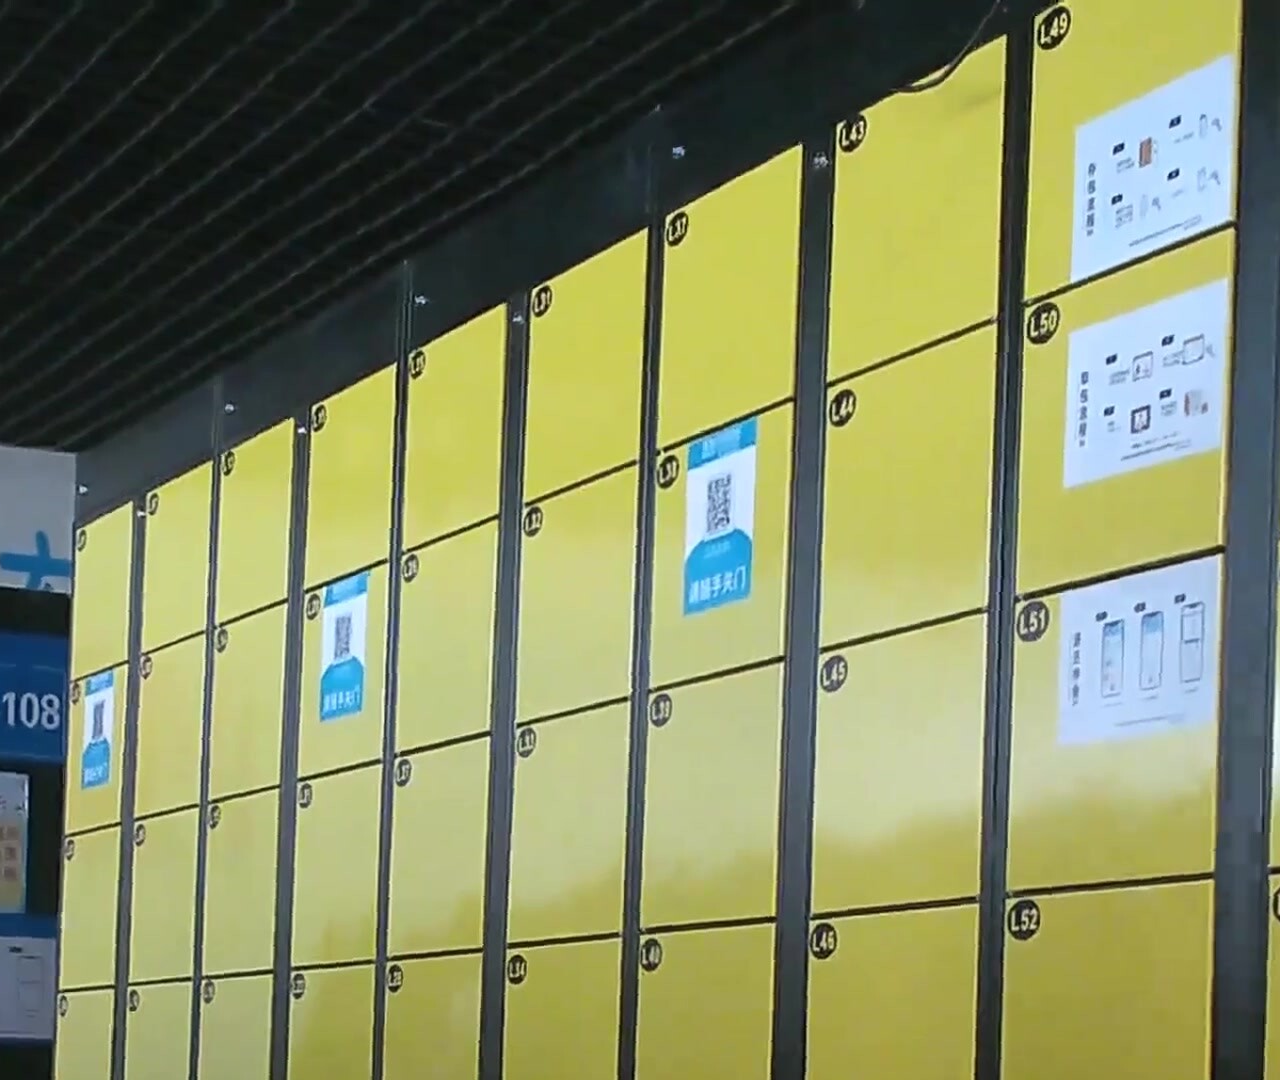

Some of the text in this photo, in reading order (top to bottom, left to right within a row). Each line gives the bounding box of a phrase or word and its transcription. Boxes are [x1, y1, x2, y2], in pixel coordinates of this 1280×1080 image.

[1040, 12, 1068, 45] L49
[1030, 310, 1057, 337] L50
[1019, 608, 1046, 635] L51
[1011, 910, 1038, 932] L52
